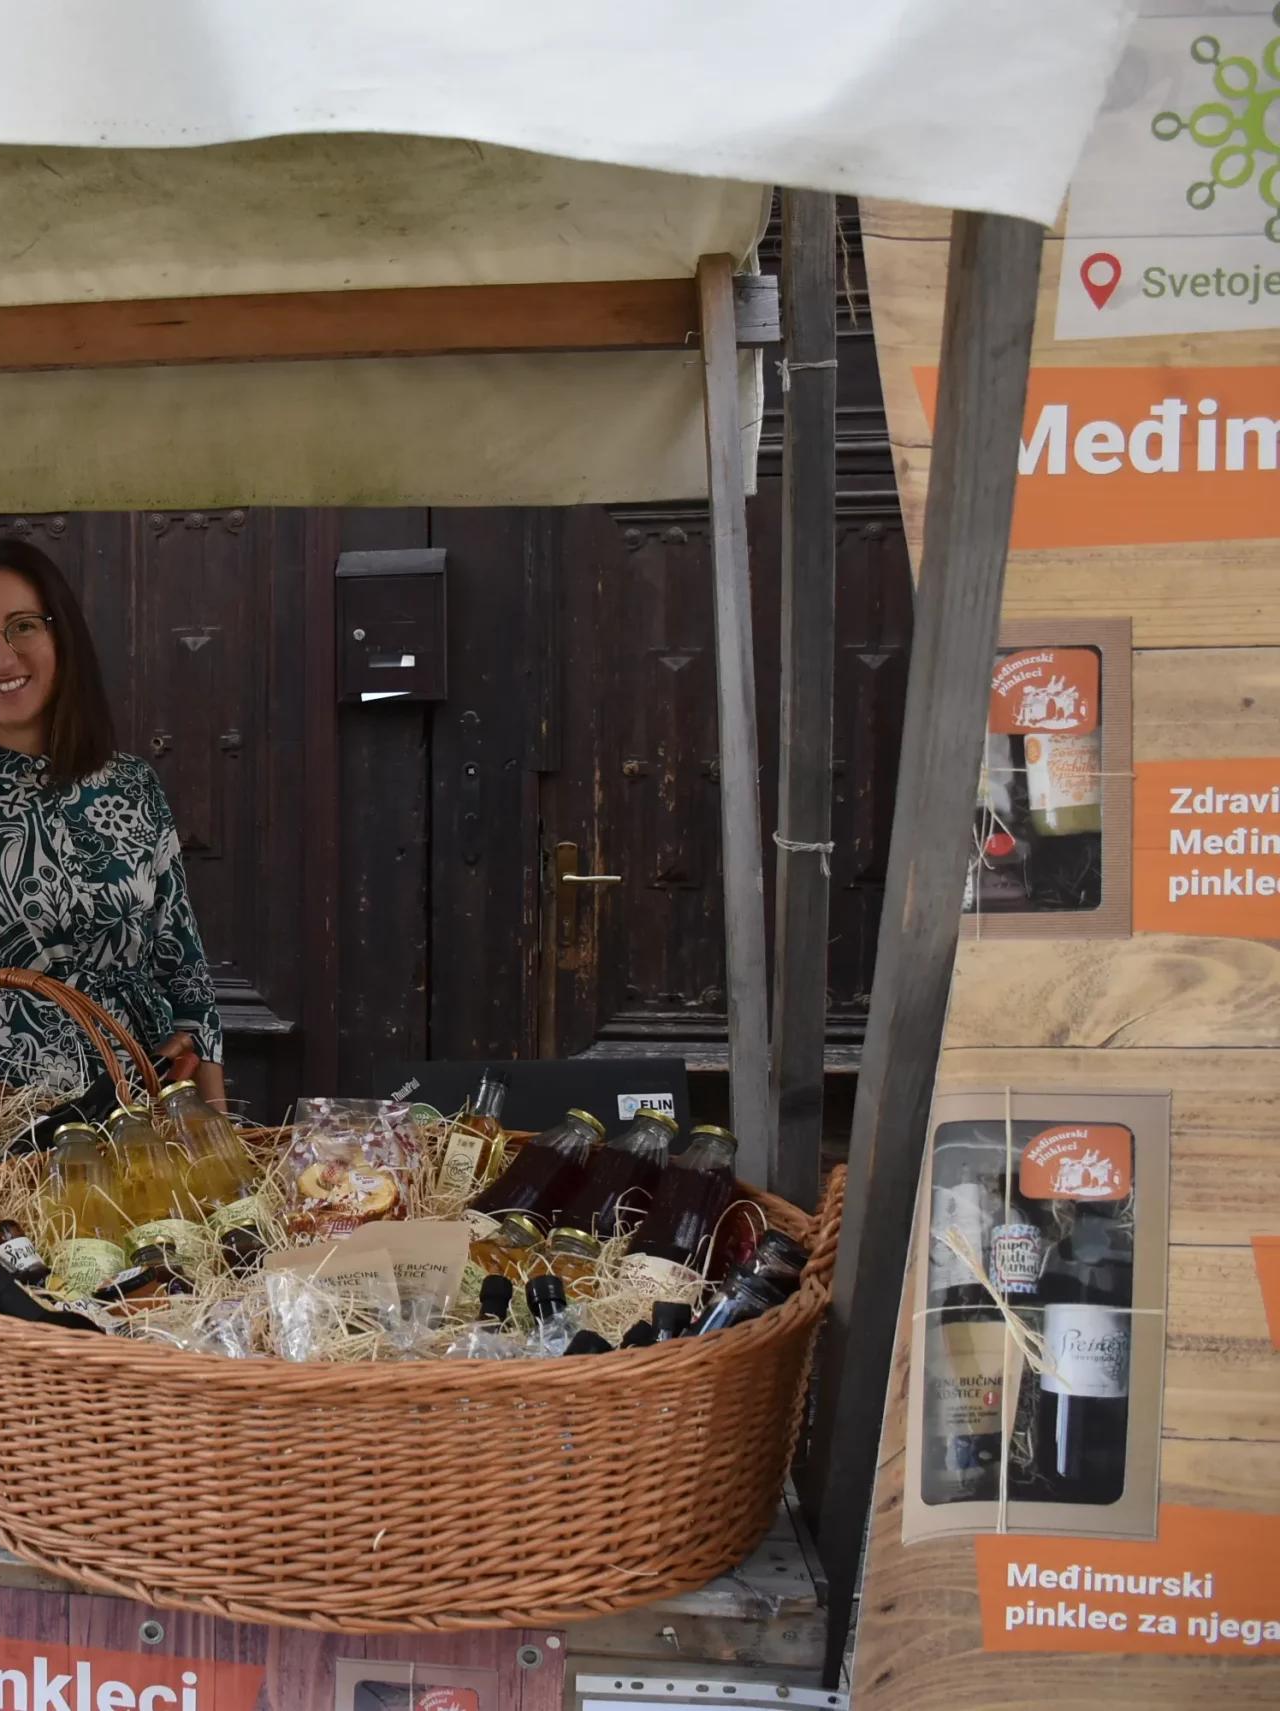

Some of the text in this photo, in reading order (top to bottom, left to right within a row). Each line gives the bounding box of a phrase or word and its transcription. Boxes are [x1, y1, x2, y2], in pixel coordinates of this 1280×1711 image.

[1169, 786, 1280, 815] Zdravi
[1168, 868, 1280, 903] pinkle
[391, 1077, 420, 1101] ThinkPad
[1006, 1562, 1214, 1599] Međimurski
[1005, 1600, 1280, 1646] pinklec za njega
